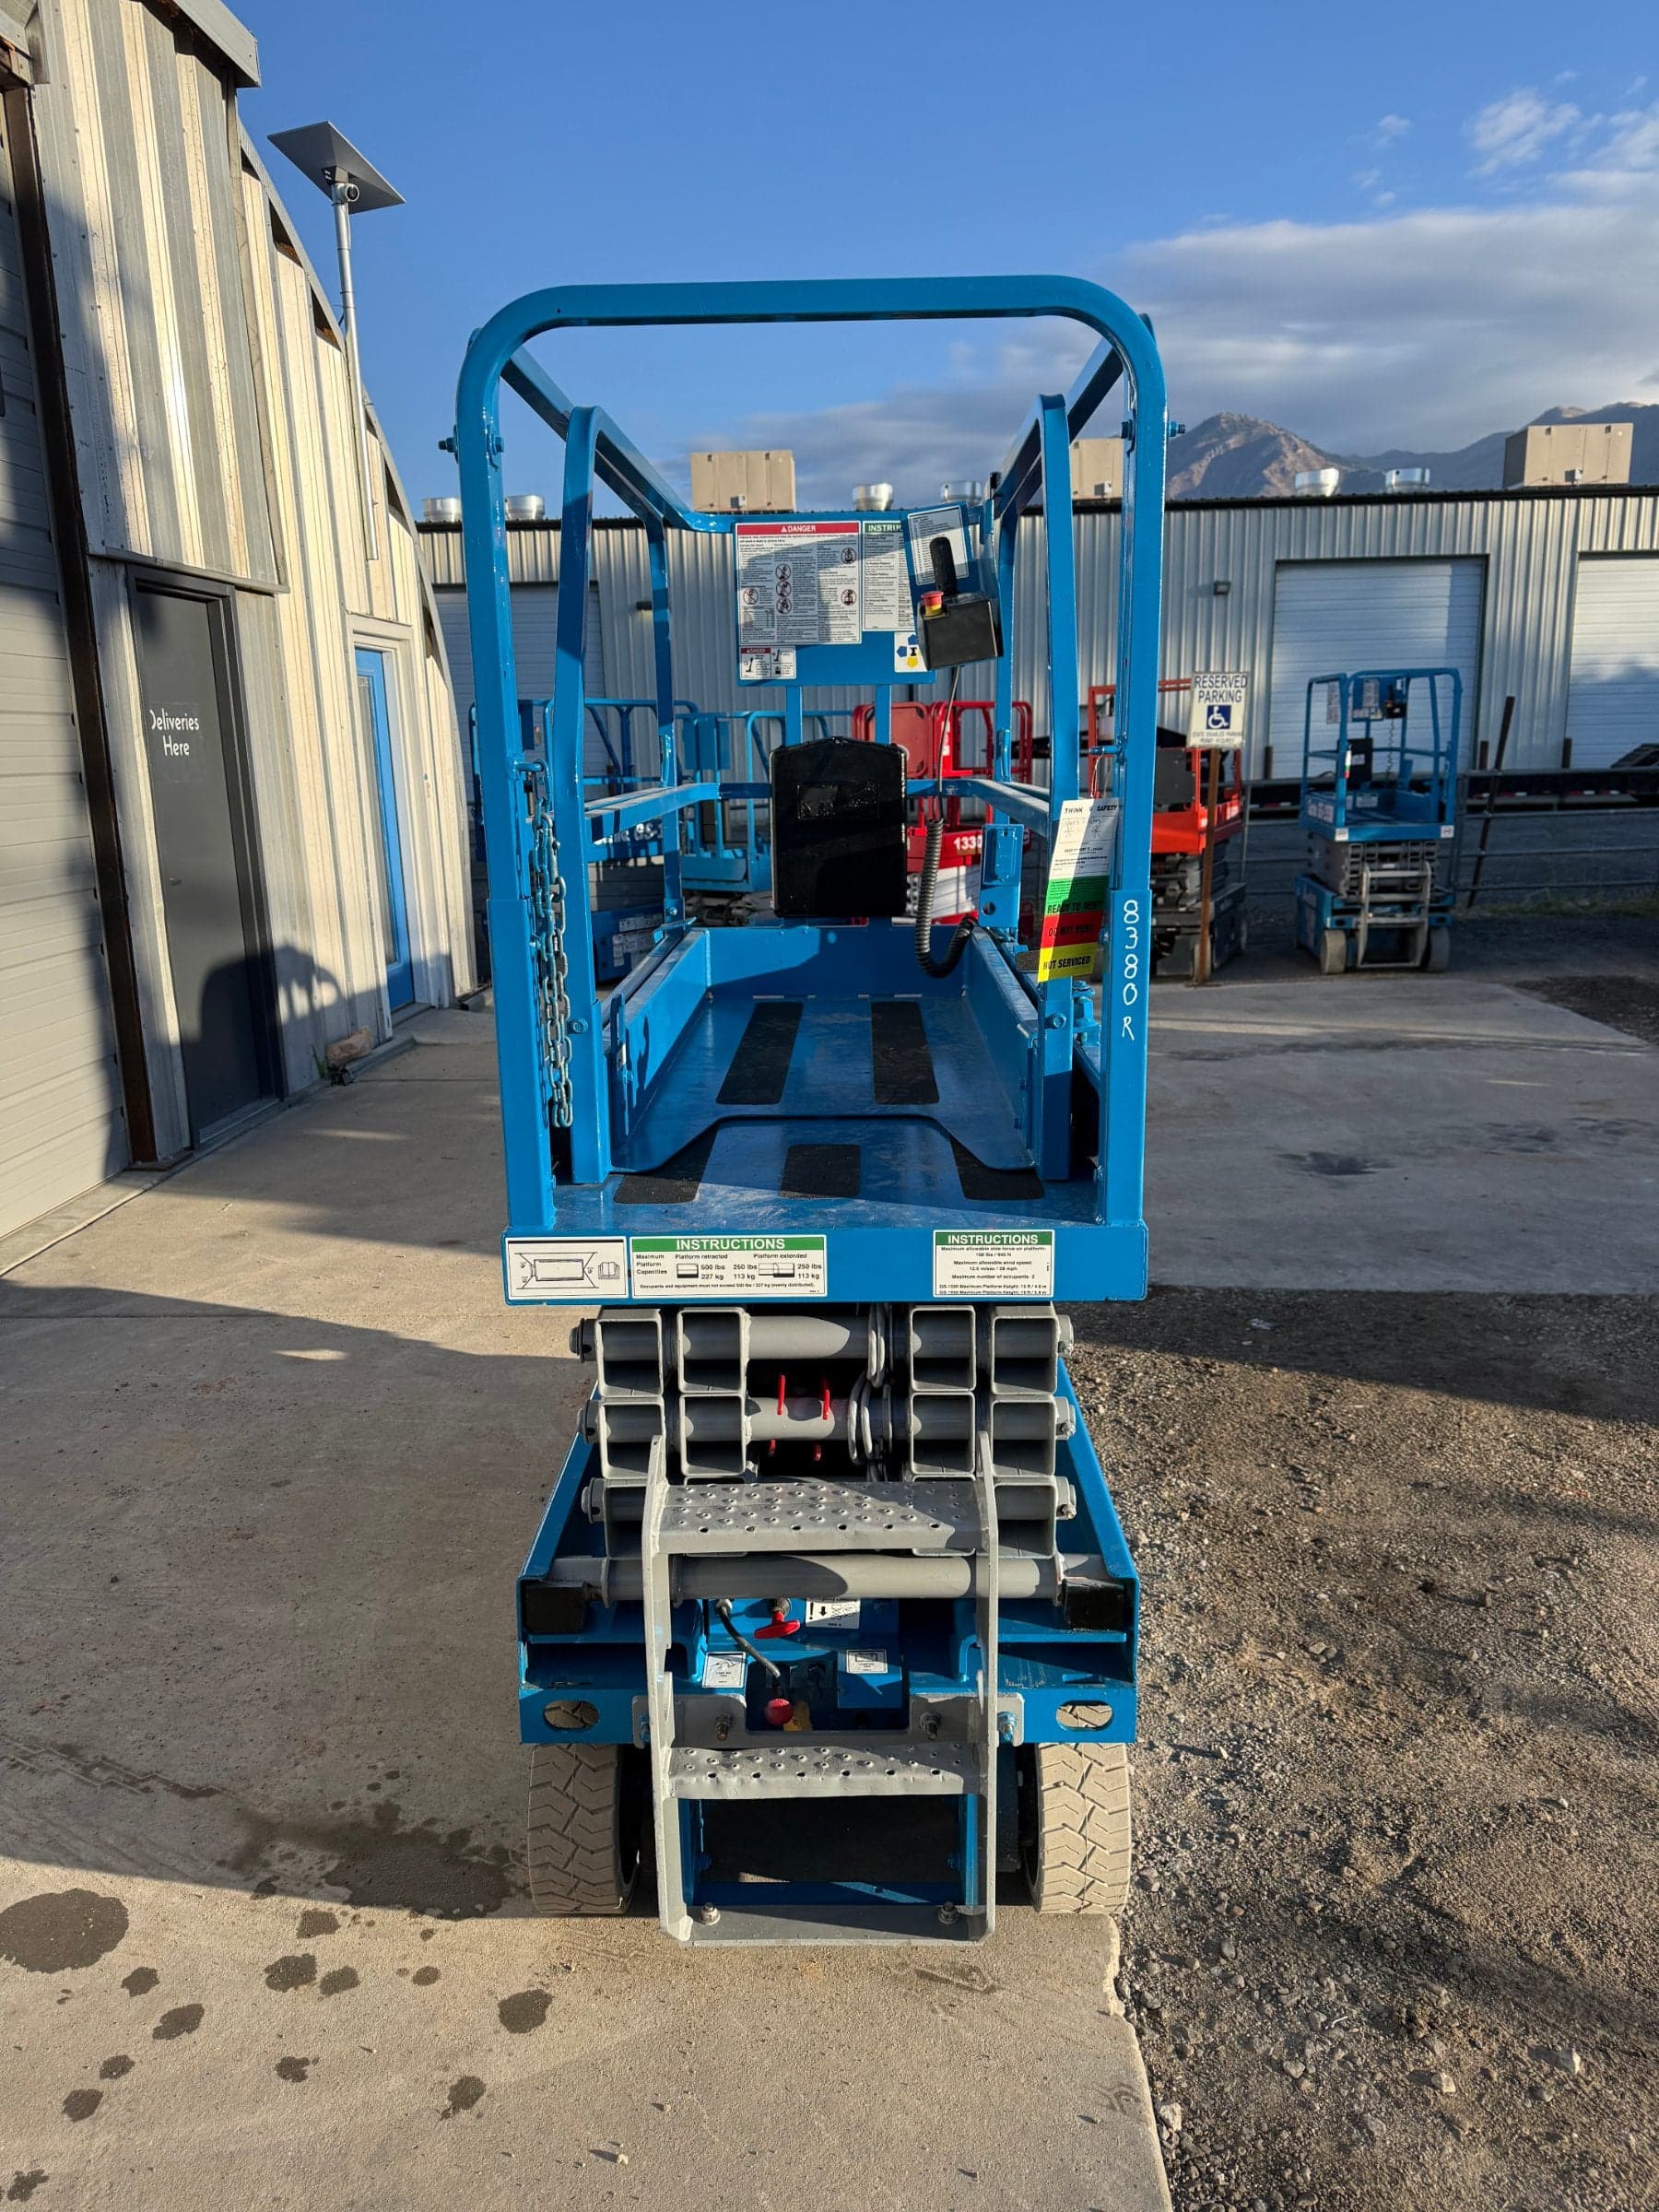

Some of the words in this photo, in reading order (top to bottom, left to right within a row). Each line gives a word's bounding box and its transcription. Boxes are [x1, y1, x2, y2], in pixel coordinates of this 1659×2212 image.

[1194, 675, 1248, 688] RESERVED
[1198, 689, 1242, 702] PARKING
[162, 735, 190, 756] Here
[1043, 959, 1057, 971] NOT
[1058, 955, 1091, 968] SERVICED
[676, 1239, 785, 1250] INSTRUCTIONS
[947, 1235, 1039, 1244] INSTRUCTIONS
